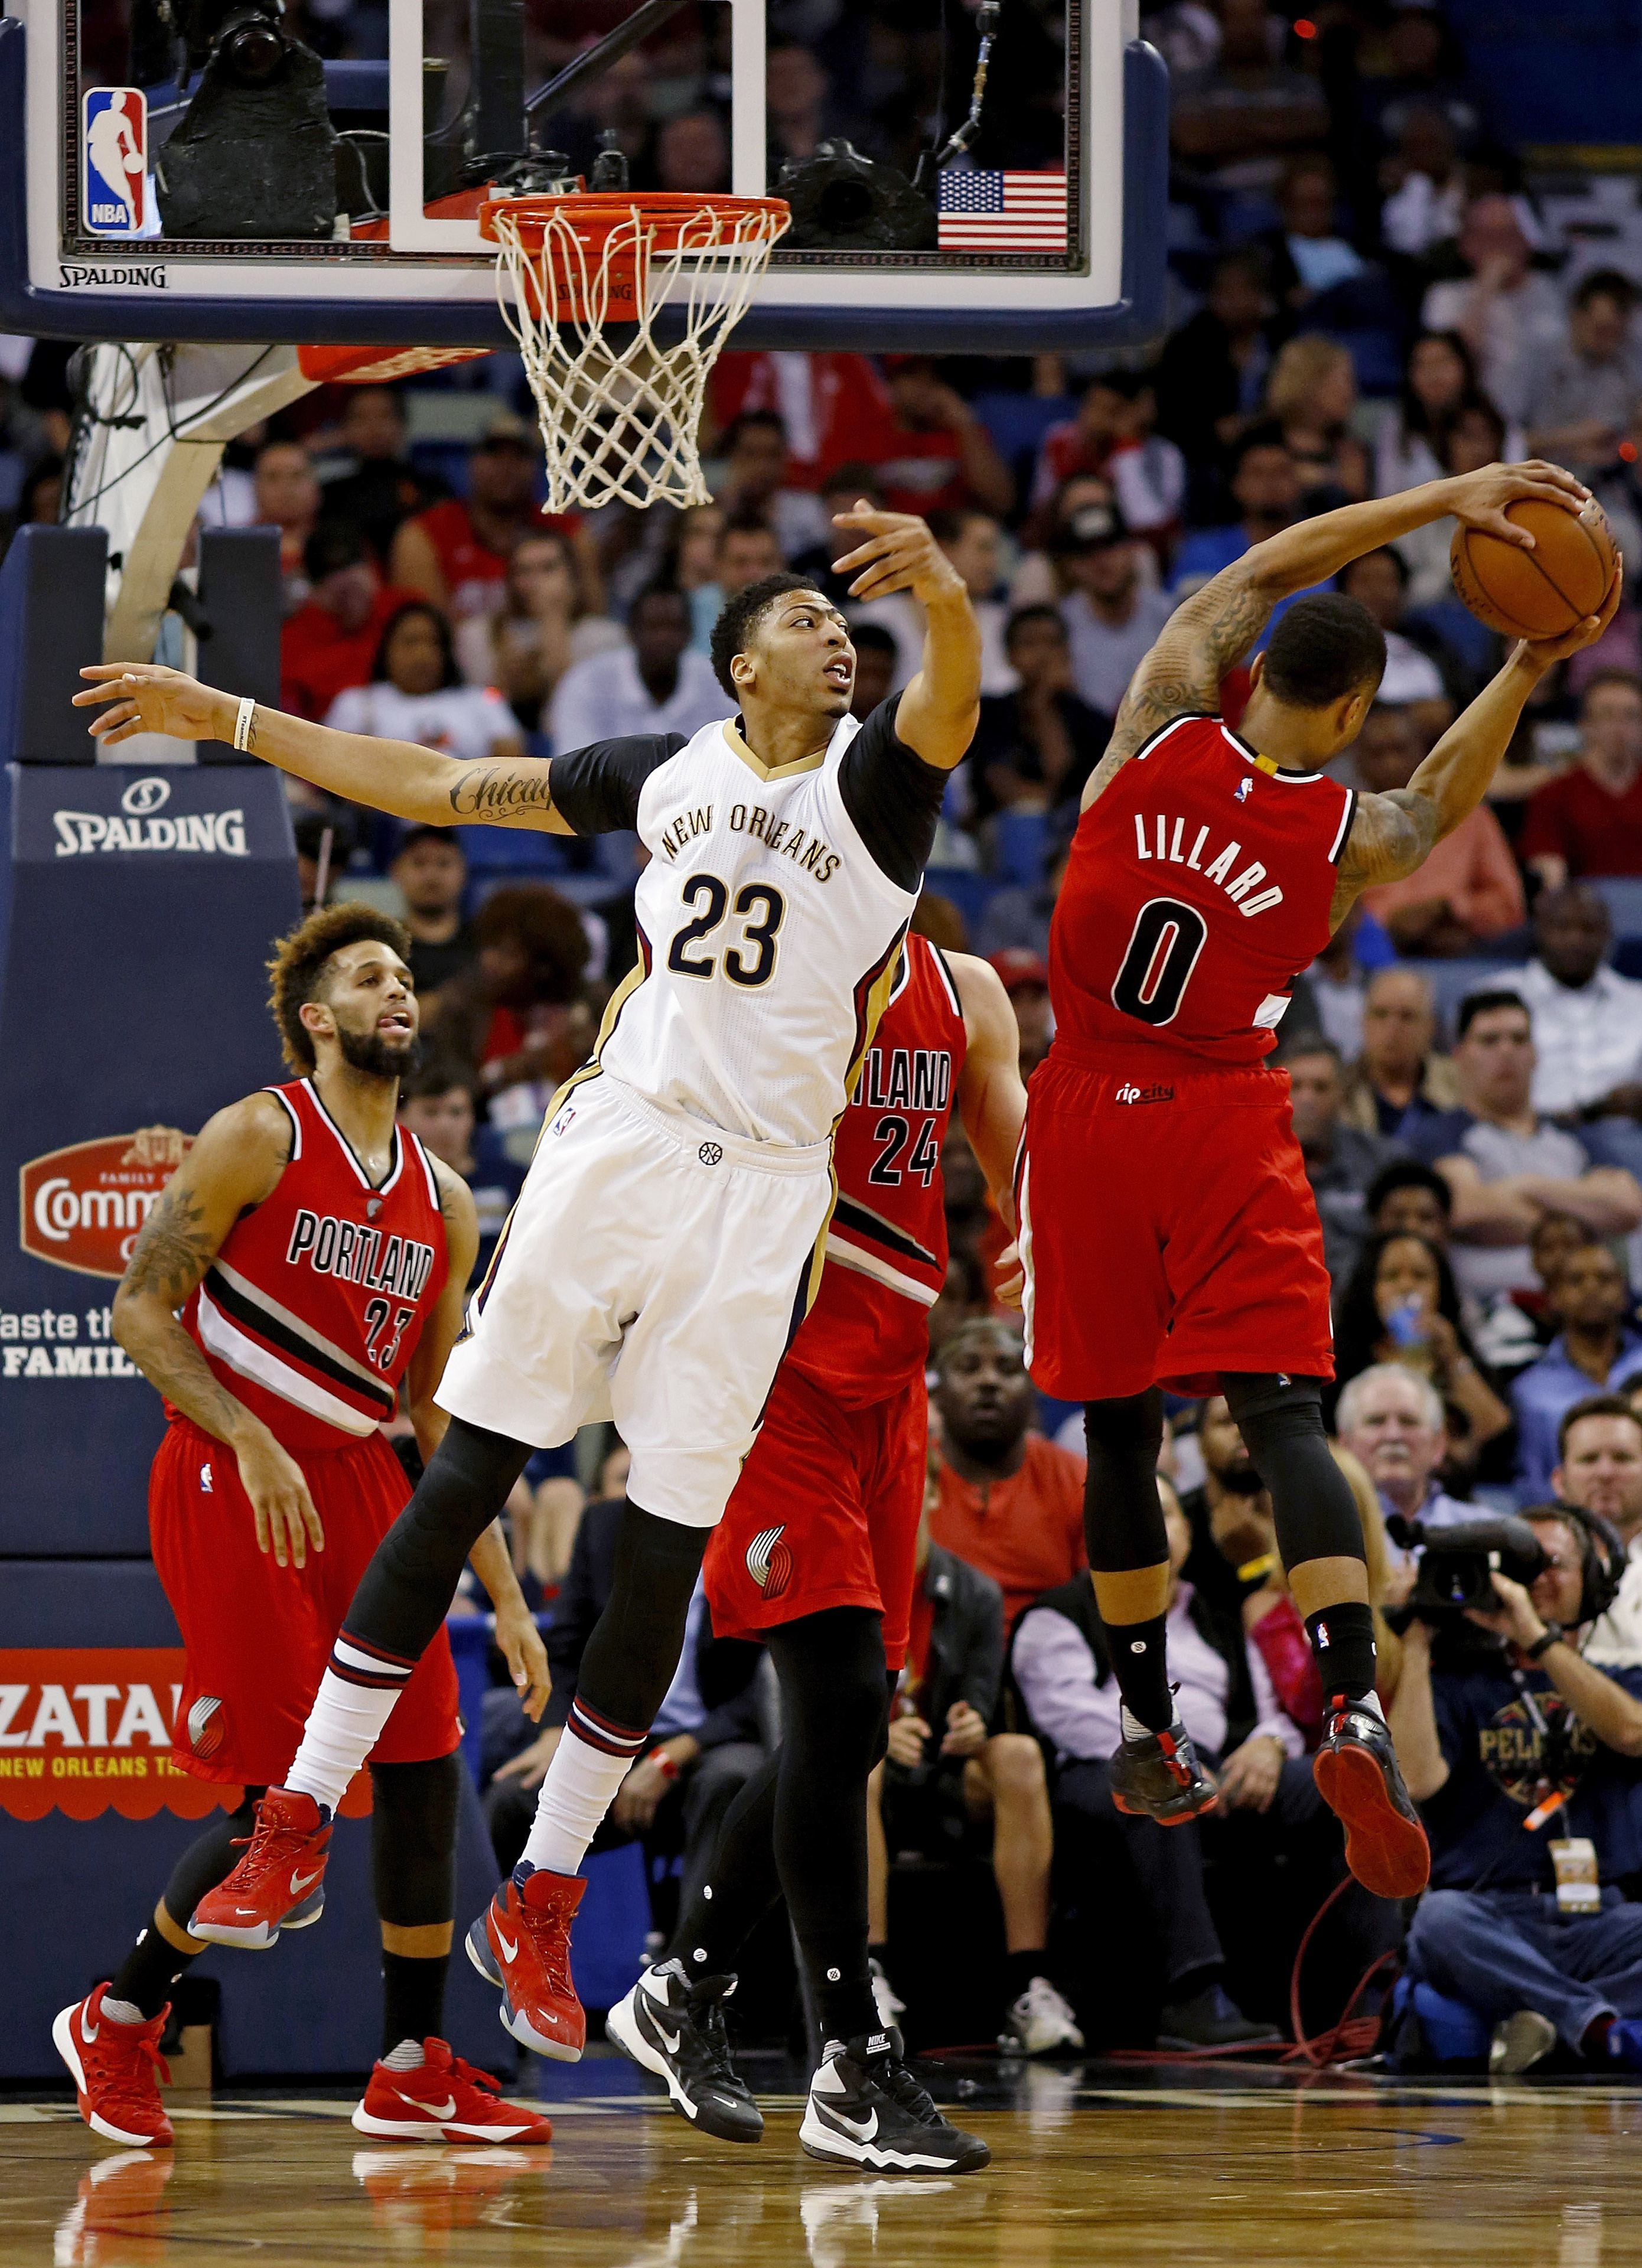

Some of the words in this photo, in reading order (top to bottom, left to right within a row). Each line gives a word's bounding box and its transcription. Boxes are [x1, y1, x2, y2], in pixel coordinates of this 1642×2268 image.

[92, 204, 128, 223] NBA
[60, 265, 169, 288] SPALDING
[450, 767, 553, 819] Chicag
[53, 808, 249, 856] SPALDING
[661, 804, 713, 861] NEW
[729, 804, 842, 882] ORLEANS
[1134, 813, 1283, 917] LILLARD
[667, 872, 786, 989] 23
[1111, 897, 1208, 1027] 0
[868, 1115, 939, 1188] 24
[34, 1178, 161, 1241] Comm
[285, 1208, 435, 1302] PORTLAND
[0, 1308, 78, 1341] aste
[363, 1297, 416, 1371] 23
[2, 1345, 144, 1378] FAMIL
[0, 1683, 183, 1748] ZATA
[0, 1757, 45, 1777] NEW
[51, 1756, 148, 1778] ORLEANS
[868, 2033, 886, 2047] NIKE
